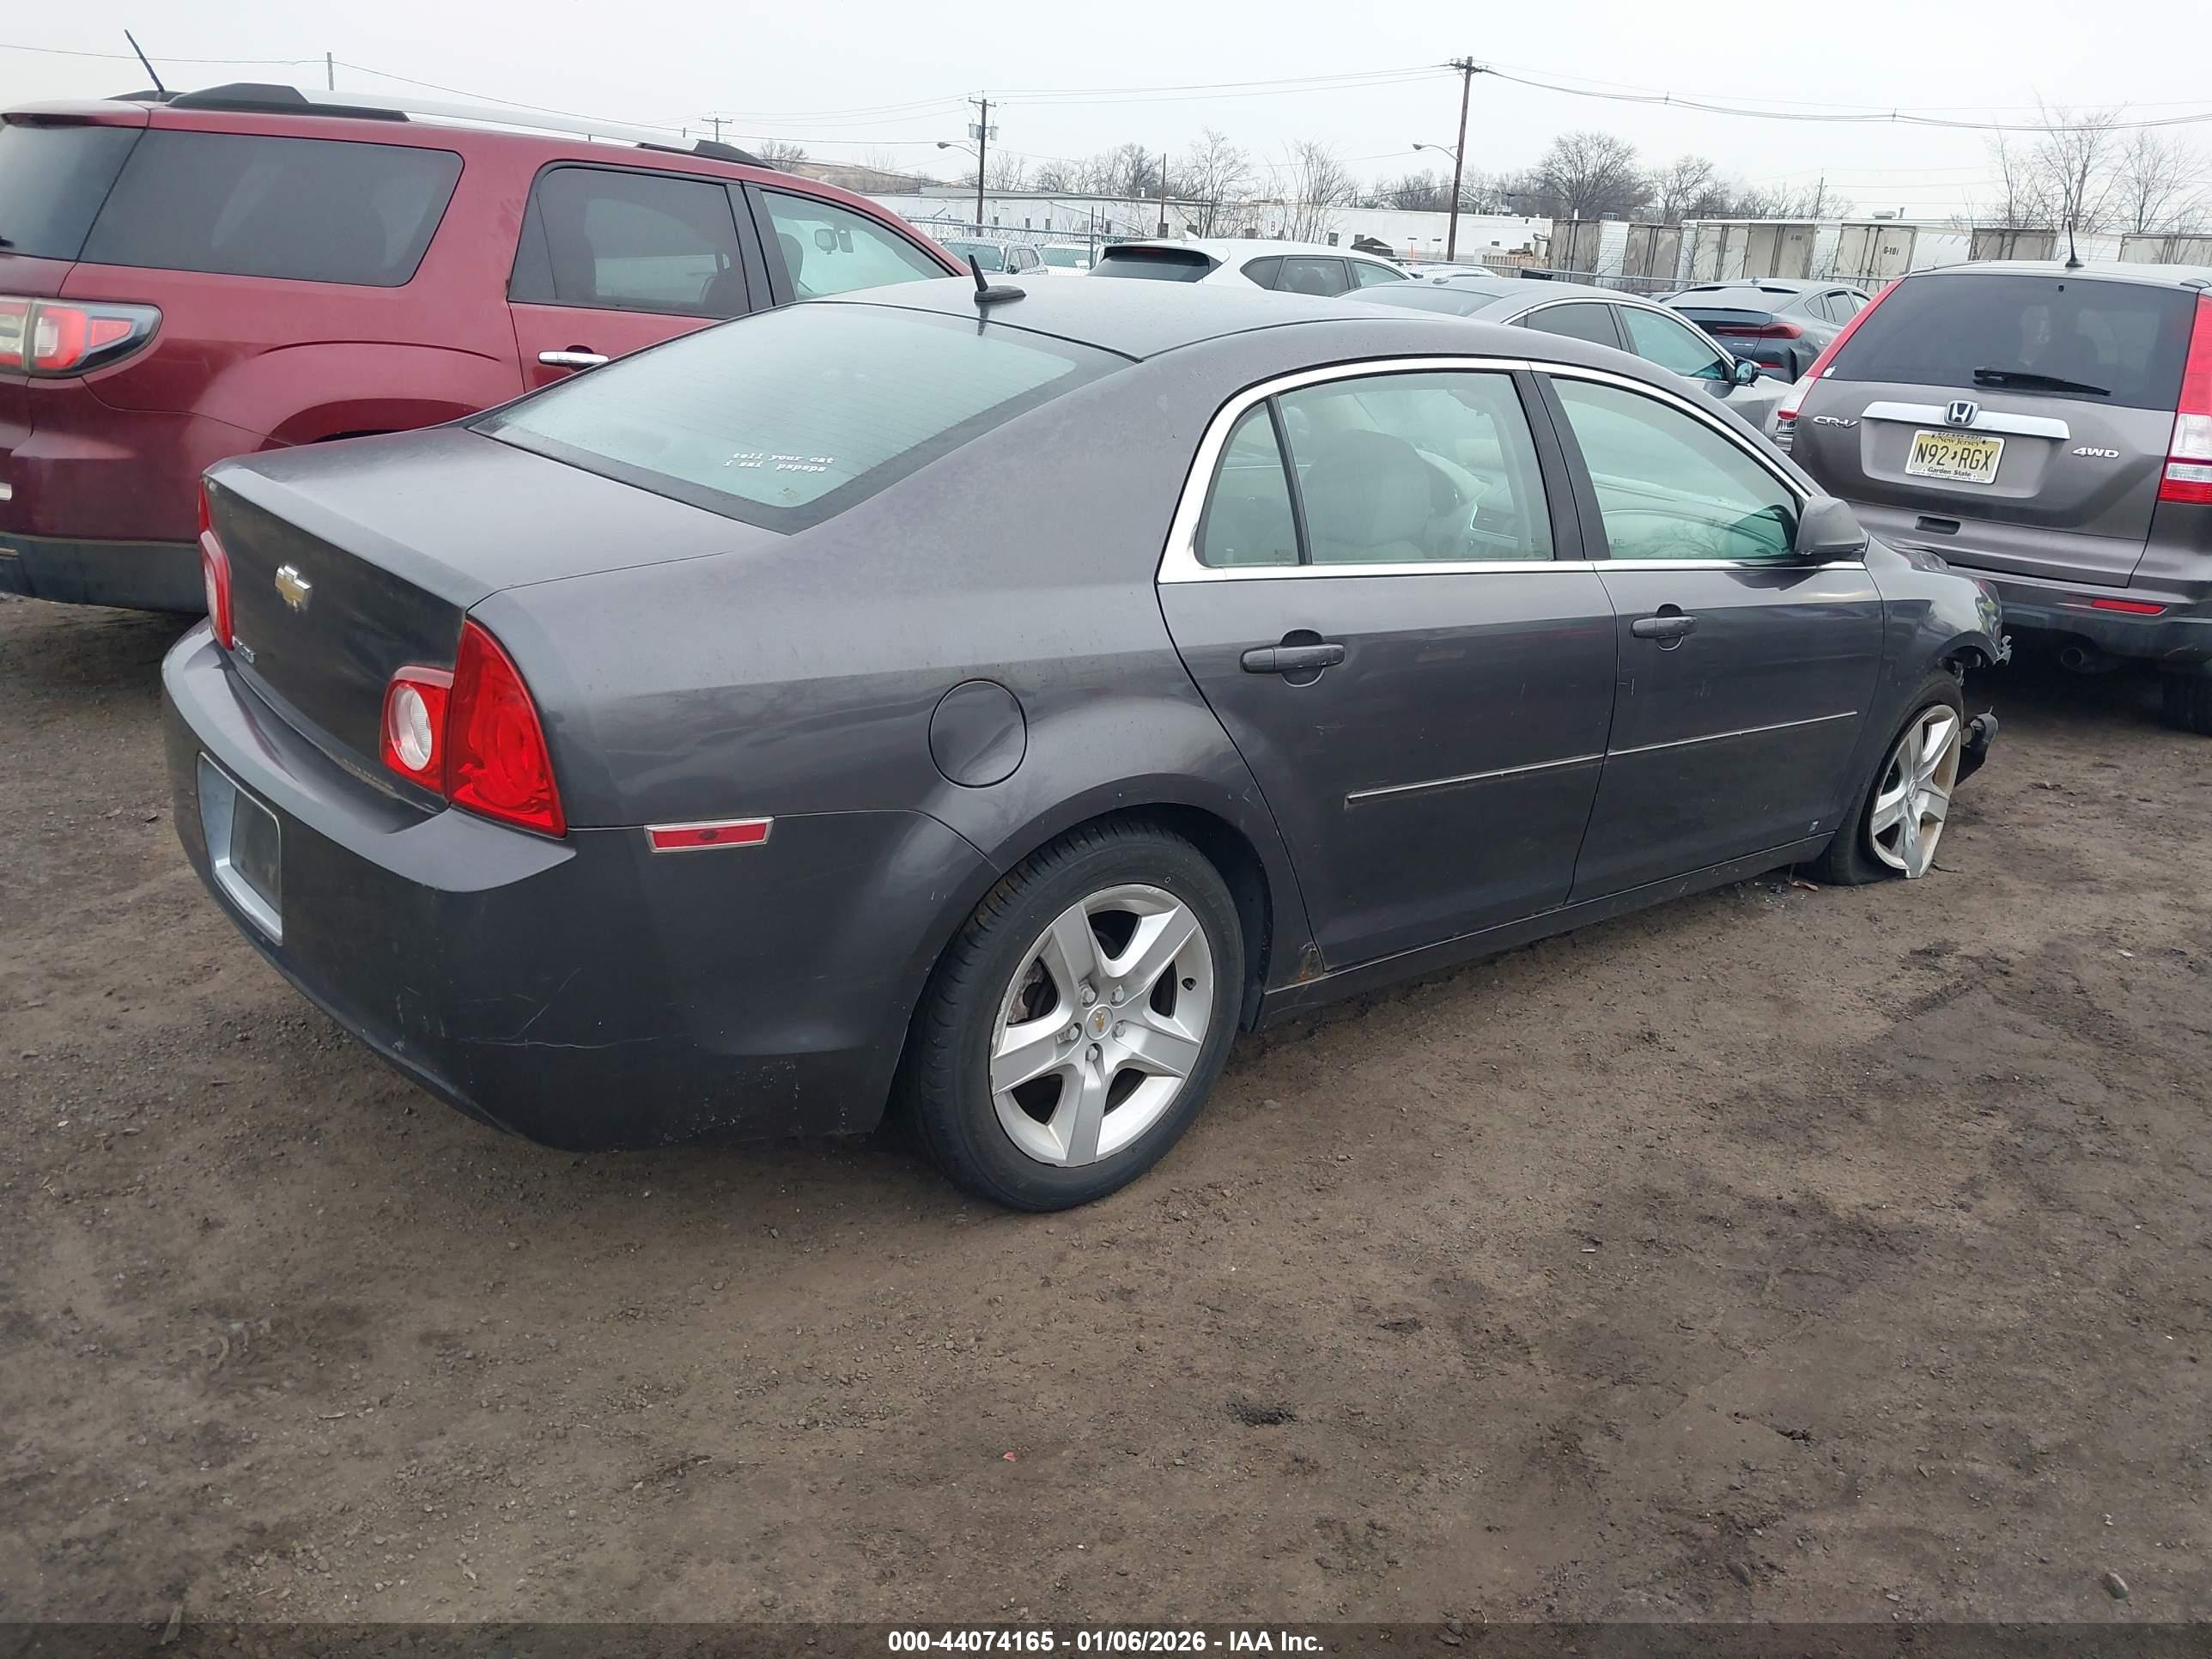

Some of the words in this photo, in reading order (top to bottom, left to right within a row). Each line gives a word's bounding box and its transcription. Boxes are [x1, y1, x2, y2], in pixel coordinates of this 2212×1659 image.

[1813, 416, 1859, 428] CR-V
[1937, 435, 1956, 445] New
[1956, 437, 1981, 447] Jersey
[2072, 447, 2119, 458] 4WD
[776, 464, 827, 472] pspsps
[1928, 466, 1952, 475] Garden
